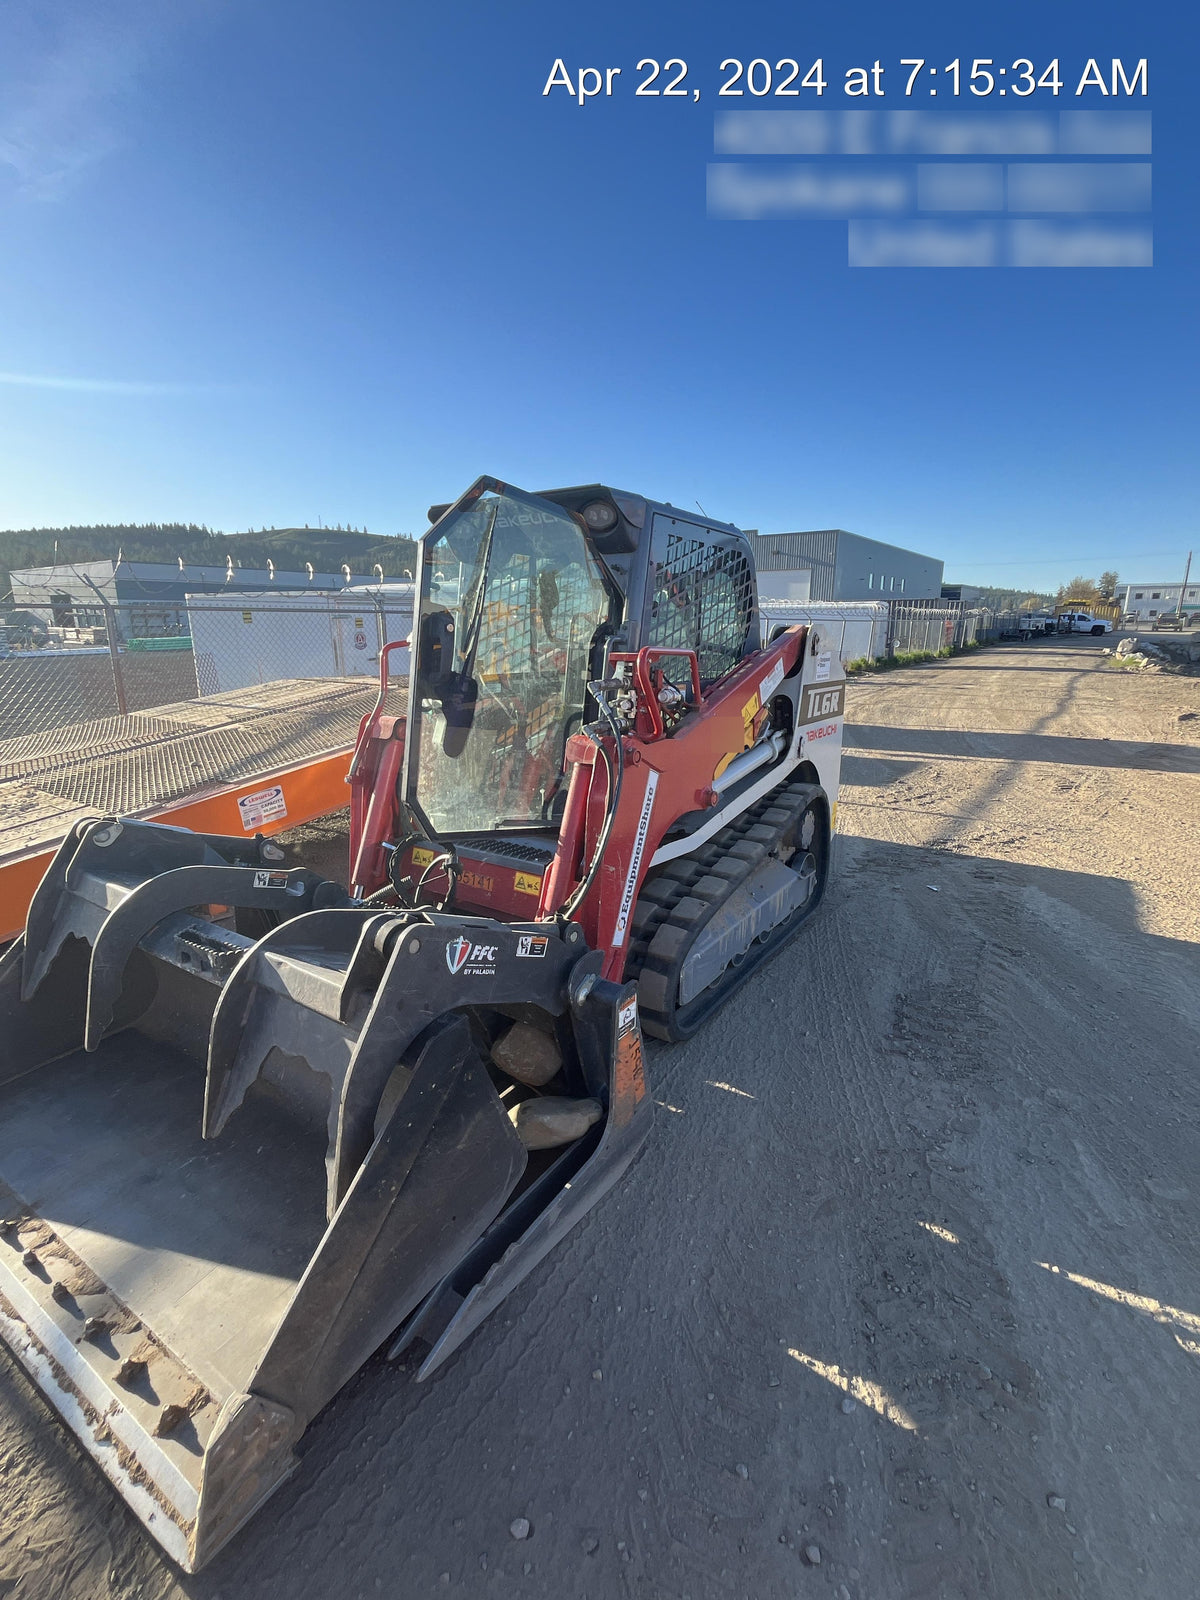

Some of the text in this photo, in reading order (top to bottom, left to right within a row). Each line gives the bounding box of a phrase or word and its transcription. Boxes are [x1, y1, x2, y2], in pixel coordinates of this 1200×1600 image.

[807, 685, 843, 719] TL6R
[806, 723, 838, 742] TAKEUCHI
[621, 787, 654, 914] EquipmentShare
[470, 944, 497, 961] FFC
[463, 968, 496, 976] BY PALADIN
